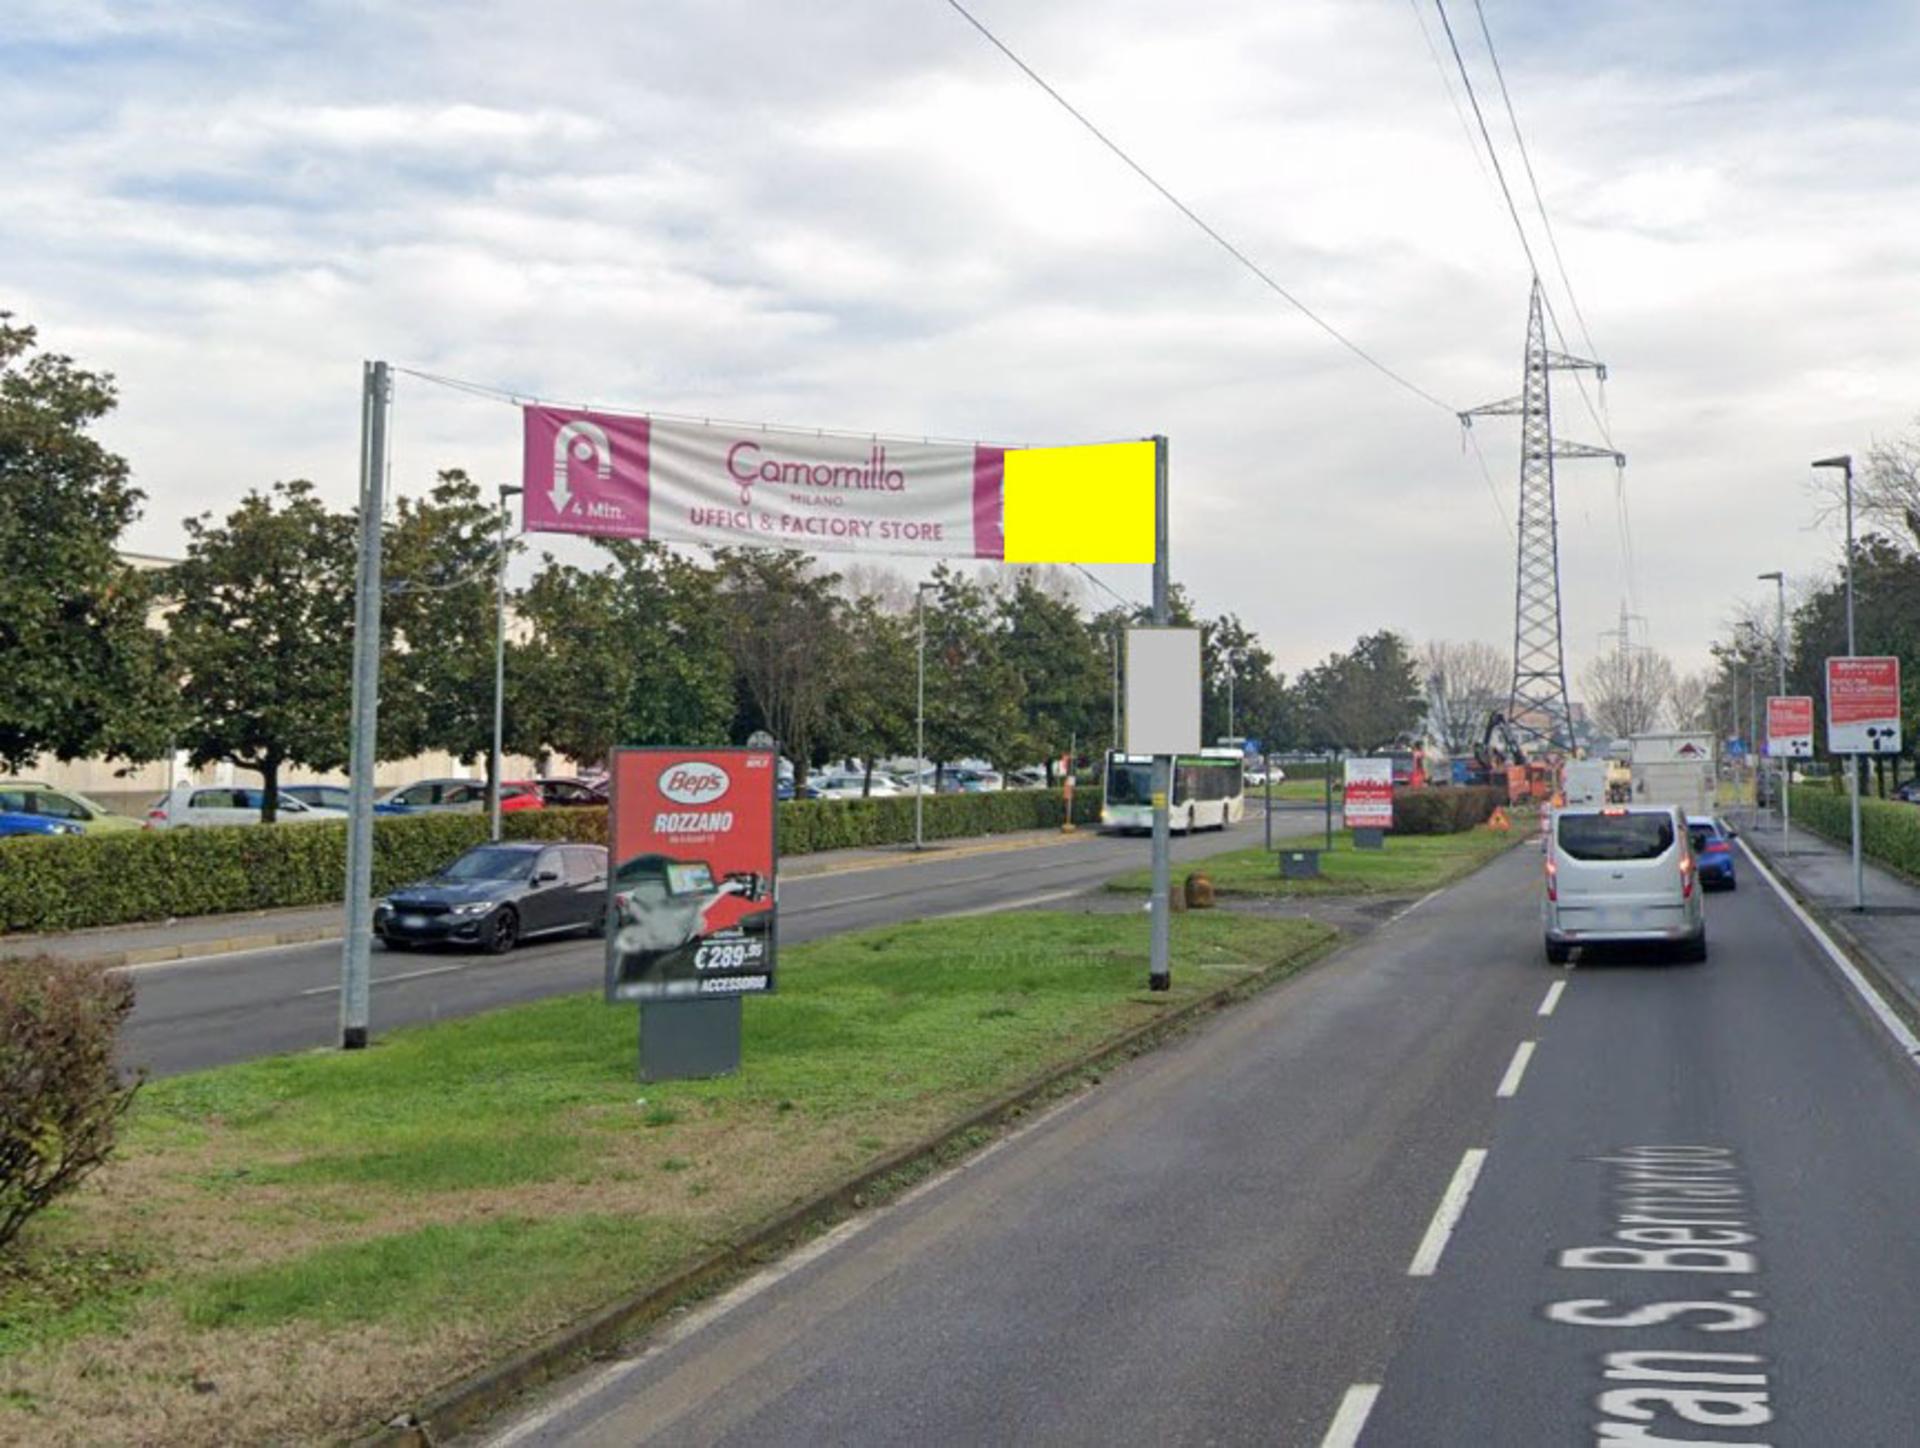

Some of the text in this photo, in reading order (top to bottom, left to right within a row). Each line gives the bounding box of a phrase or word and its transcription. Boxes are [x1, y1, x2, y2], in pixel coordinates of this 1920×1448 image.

[727, 441, 905, 492] Camomilla
[571, 502, 627, 520] 4 Min.
[790, 493, 844, 507] MILANO
[690, 508, 944, 541] UFFICI & FACTORY STORE
[654, 811, 734, 833] ROZZANO
